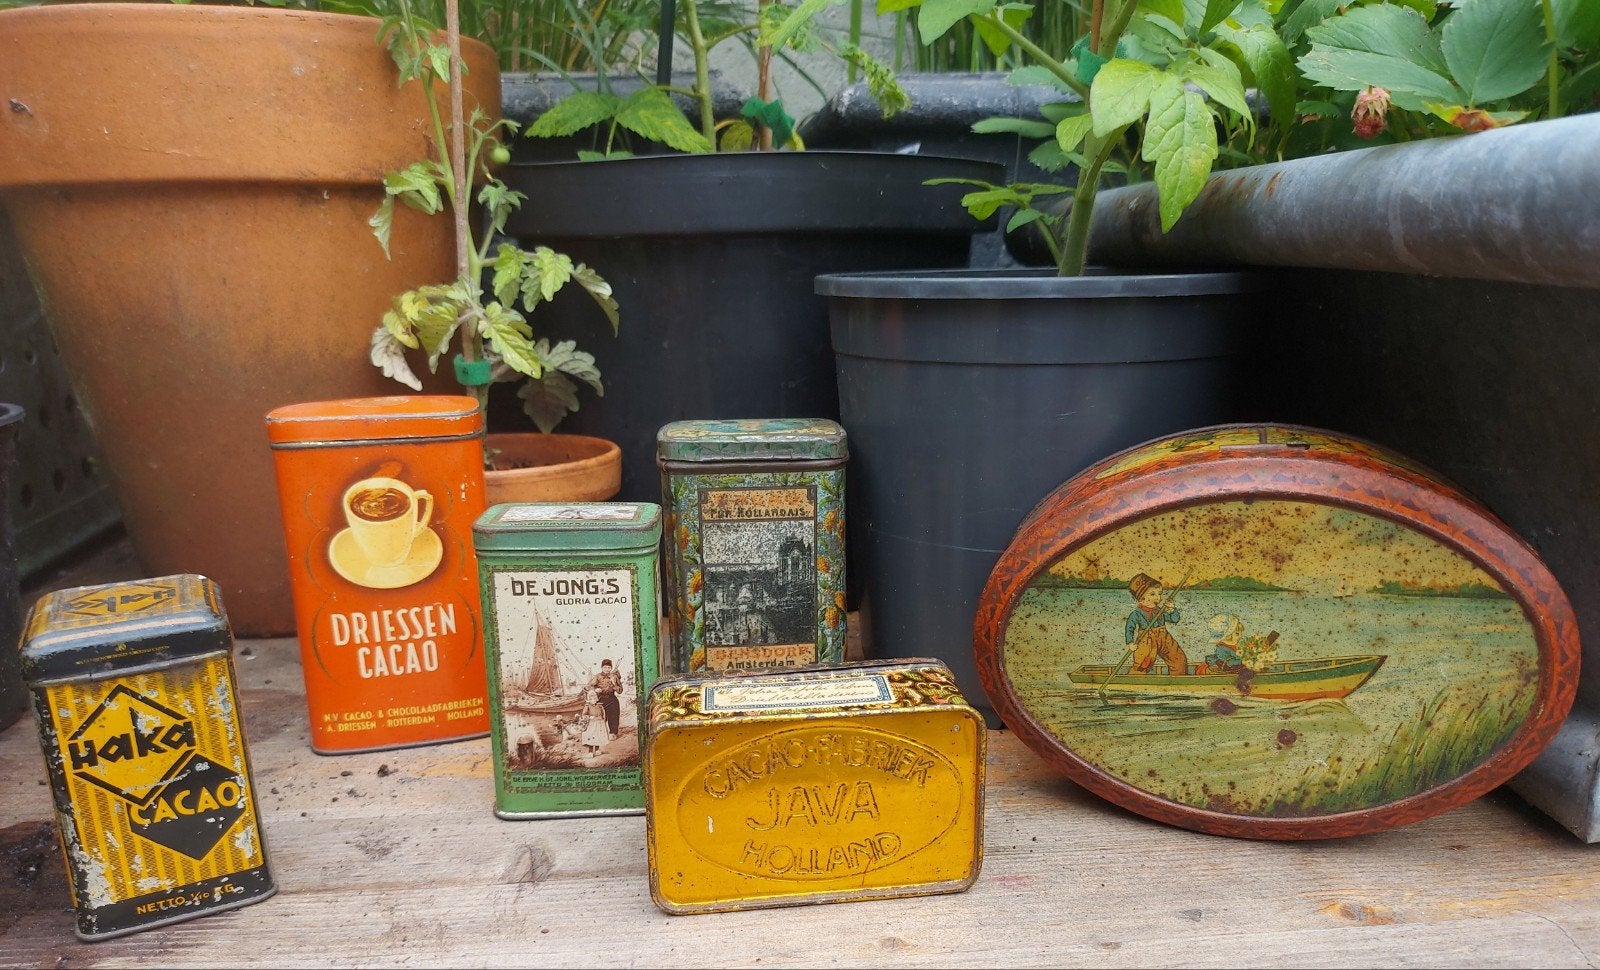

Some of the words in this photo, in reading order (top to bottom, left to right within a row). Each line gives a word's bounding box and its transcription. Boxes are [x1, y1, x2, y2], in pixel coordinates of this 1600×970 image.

[511, 580, 539, 597] DE
[542, 578, 620, 596] JONG'S
[556, 597, 592, 606] GLORIA
[594, 596, 627, 605] CACAO
[331, 603, 457, 646] DRIESSEN
[357, 640, 439, 679] CACAO
[726, 656, 795, 670] Amsterdam
[338, 720, 377, 732] DRIESSEN
[387, 715, 436, 728] ROTTERDAM
[446, 707, 485, 721] HOLLAND
[344, 711, 373, 721] CACAO
[387, 697, 484, 717] CHOCOLAADFABRIEKEN
[130, 780, 242, 825] CACAO
[745, 780, 881, 831] JAVA
[739, 832, 902, 875] HOLLAND
[136, 896, 186, 915] NETTO
[213, 883, 236, 903] KG
